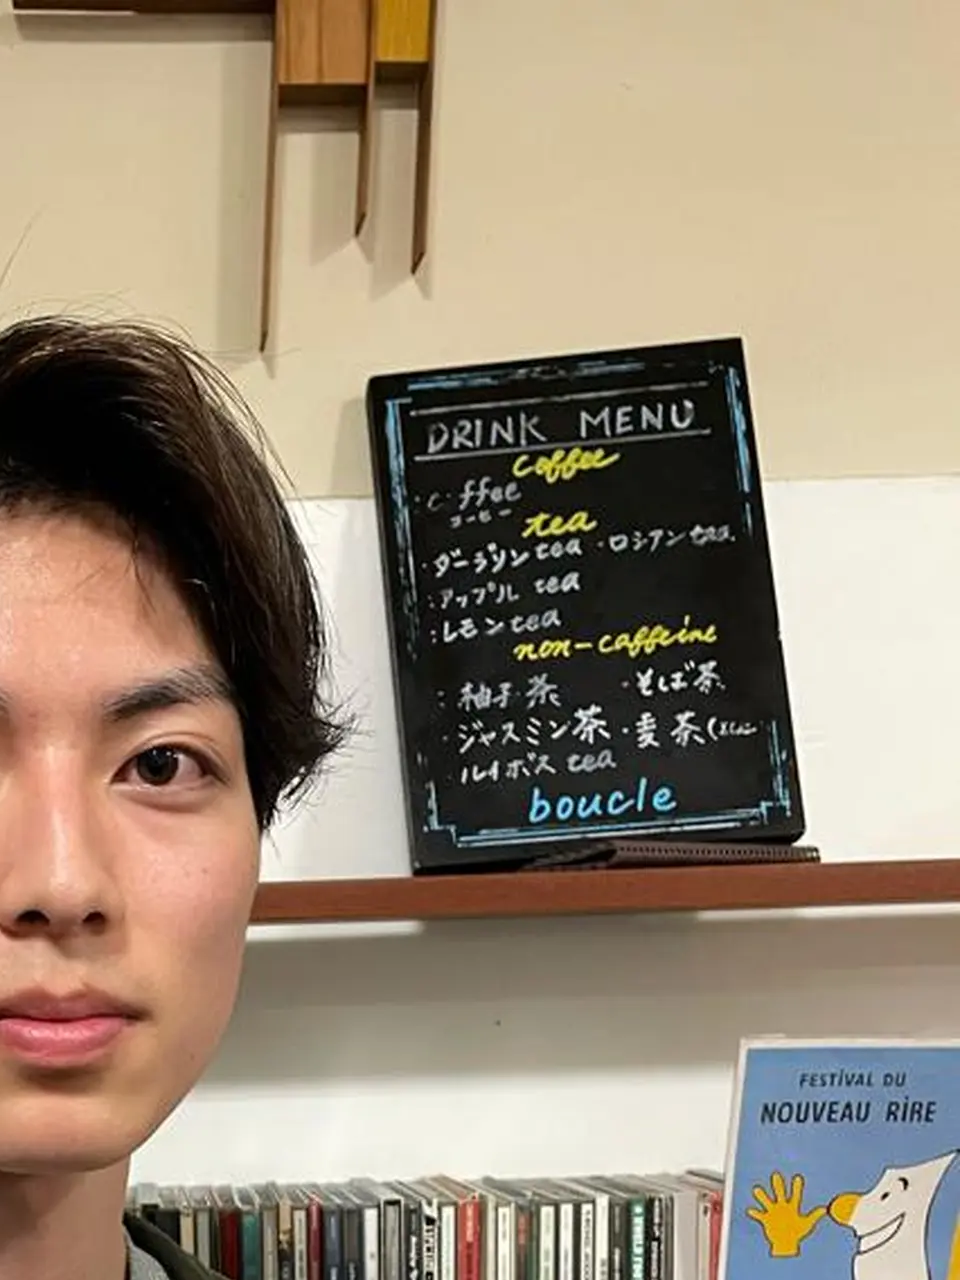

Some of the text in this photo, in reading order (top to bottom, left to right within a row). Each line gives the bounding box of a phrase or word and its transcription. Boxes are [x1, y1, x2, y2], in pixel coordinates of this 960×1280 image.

[426, 399, 695, 454] DRINK MENU
[521, 510, 598, 539] tea
[528, 775, 678, 824] boucle
[882, 1072, 907, 1087] DU
[759, 1100, 872, 1125] NOUVEAU
